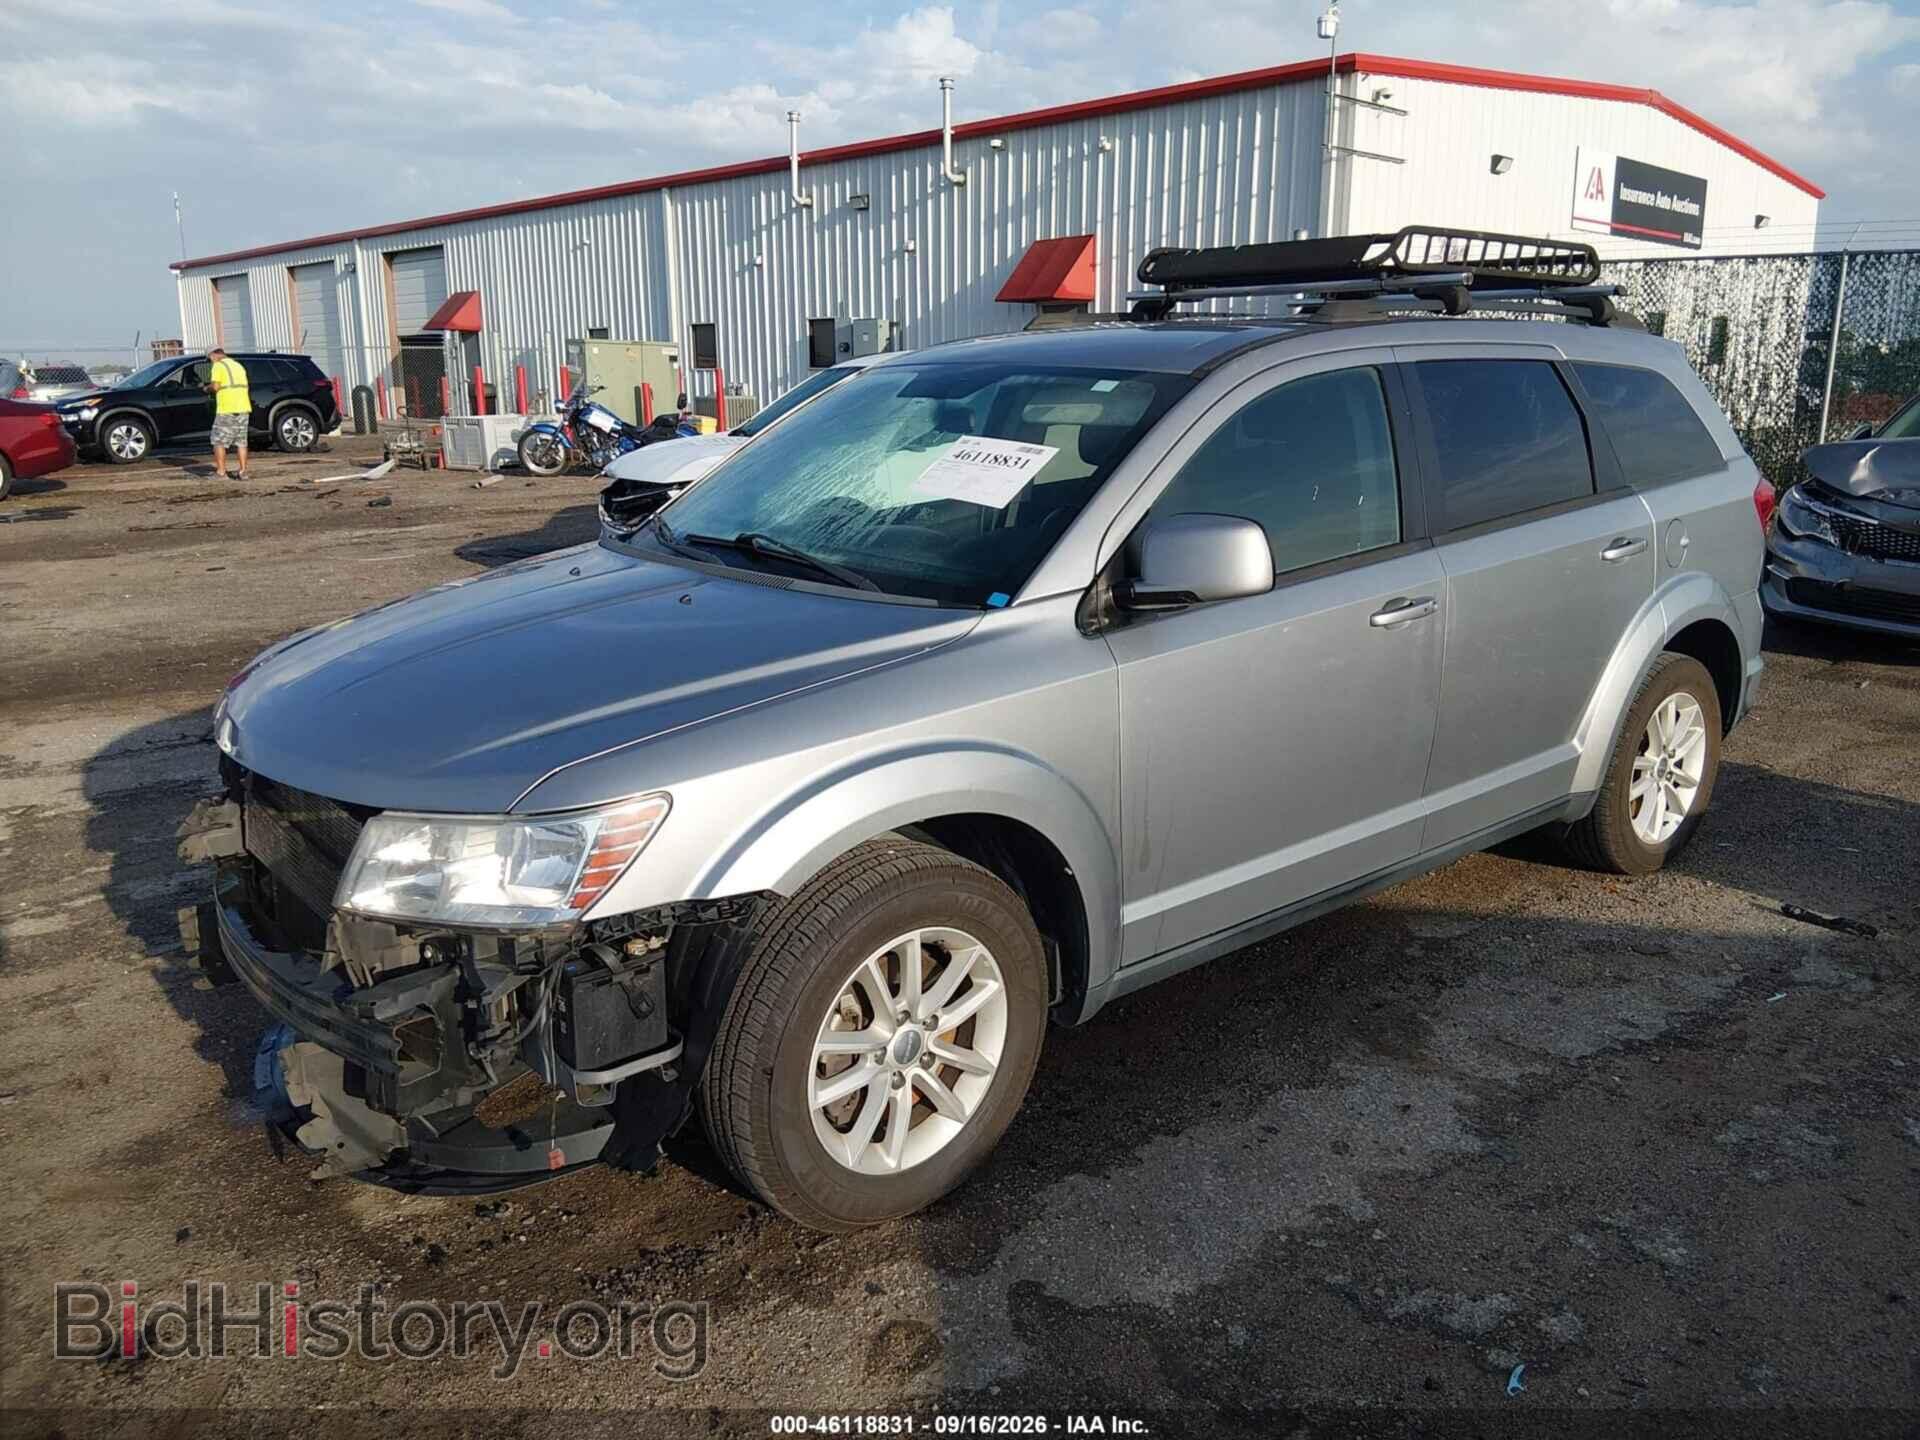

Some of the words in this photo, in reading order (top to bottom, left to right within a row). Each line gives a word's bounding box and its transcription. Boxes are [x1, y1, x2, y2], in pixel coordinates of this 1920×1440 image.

[1619, 182, 1656, 207] Insurance
[1655, 190, 1671, 209] Auto
[1672, 194, 1700, 216] Auctions
[952, 449, 1031, 470] 46118831
